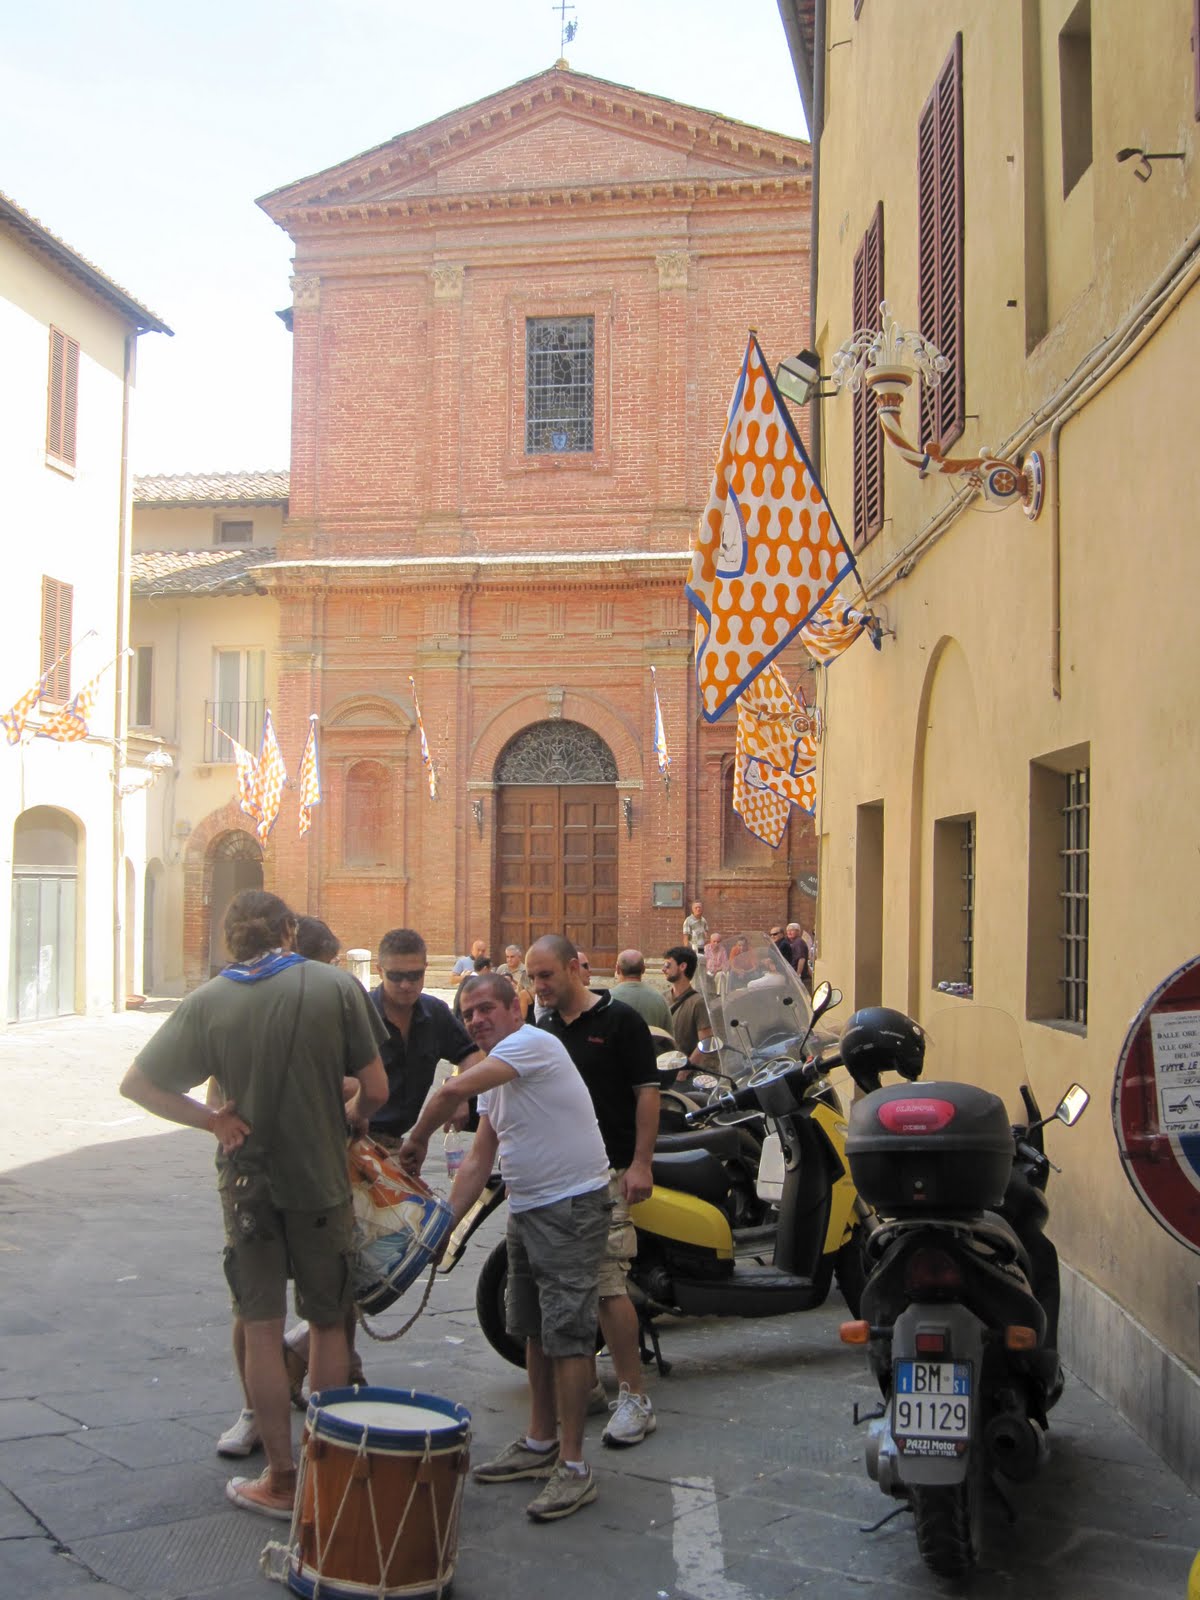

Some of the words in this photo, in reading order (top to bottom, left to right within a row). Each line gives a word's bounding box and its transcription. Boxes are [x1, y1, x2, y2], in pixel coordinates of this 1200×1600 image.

[1157, 1031, 1179, 1039] DALLE
[915, 1365, 941, 1392] BM
[899, 1401, 966, 1431] 91129
[906, 1439, 930, 1449] PAZZI
[932, 1440, 956, 1450] Motor
